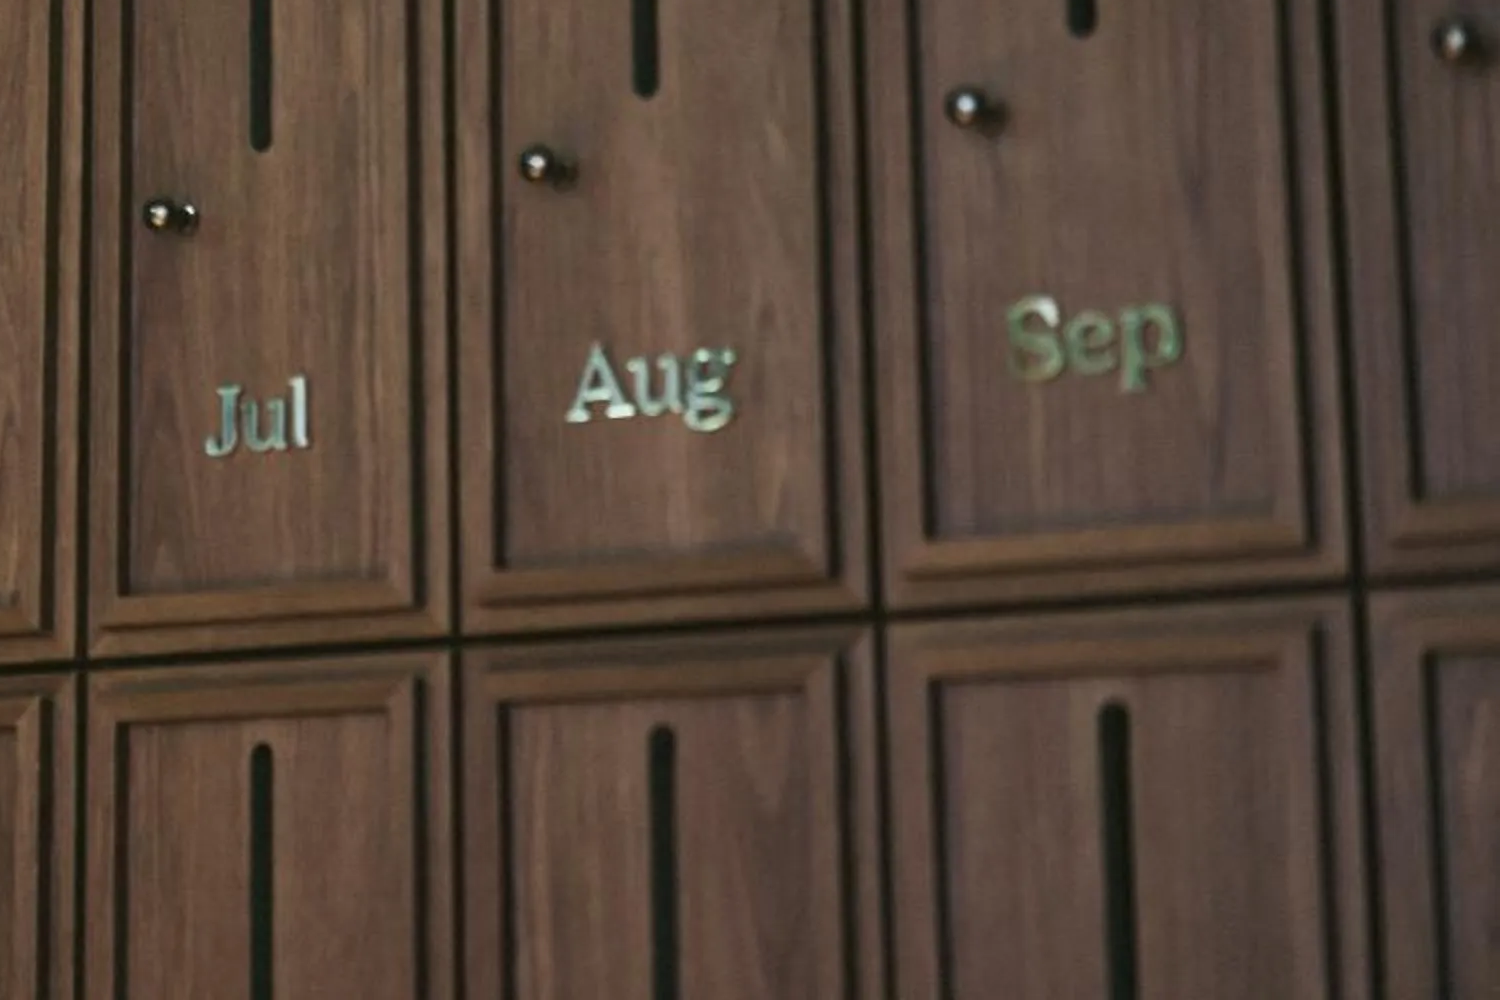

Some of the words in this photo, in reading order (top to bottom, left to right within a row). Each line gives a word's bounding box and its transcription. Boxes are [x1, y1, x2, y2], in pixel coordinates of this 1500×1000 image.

[565, 341, 736, 433] Aug
[1004, 294, 1183, 395] Sep
[204, 374, 309, 457] Jul
